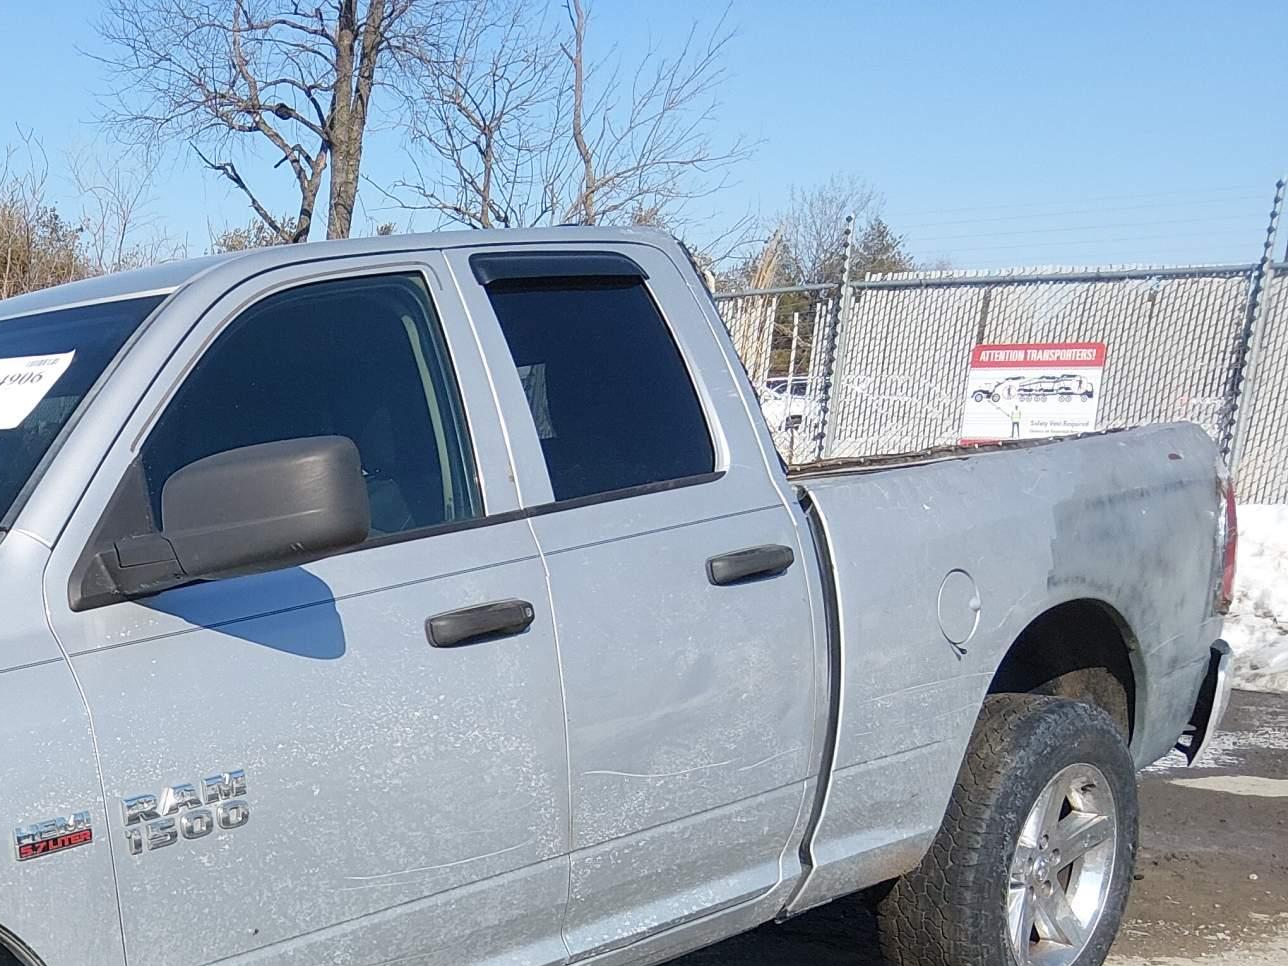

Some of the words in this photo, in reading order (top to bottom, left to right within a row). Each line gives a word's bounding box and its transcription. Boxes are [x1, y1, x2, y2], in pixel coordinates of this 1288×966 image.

[979, 350, 1025, 361] ATTENTION
[1026, 349, 1097, 360] TRANSPORTERS!
[121, 769, 248, 827] RAM
[20, 841, 45, 859] 5.7
[48, 830, 91, 850] LITER
[124, 800, 250, 856] 1500
